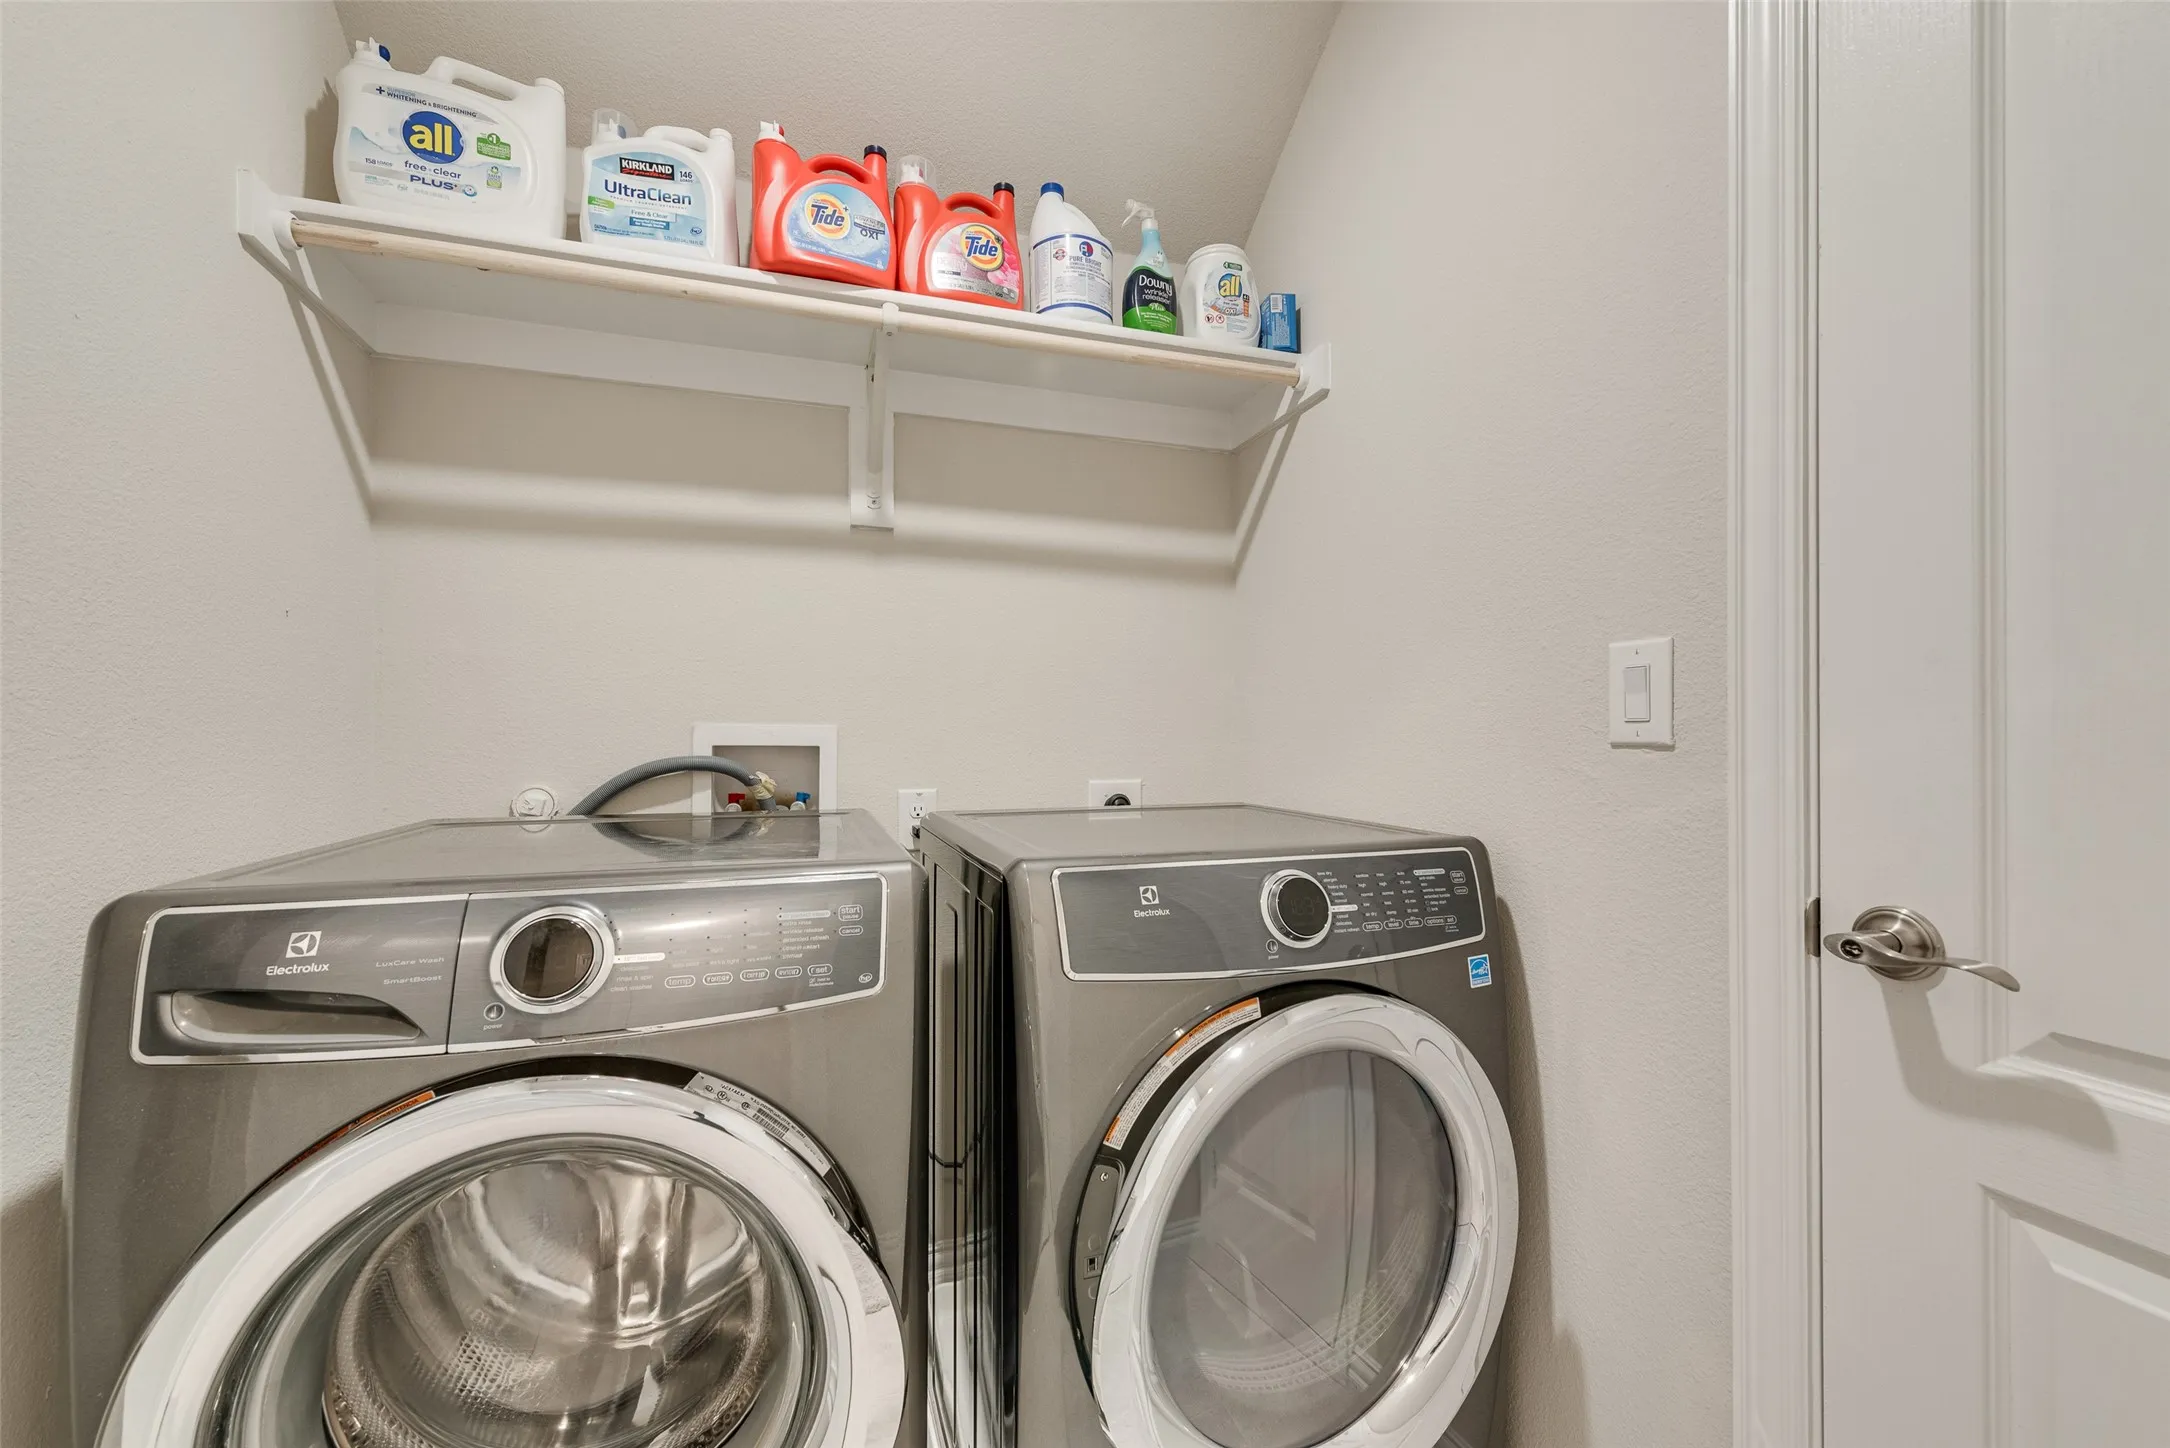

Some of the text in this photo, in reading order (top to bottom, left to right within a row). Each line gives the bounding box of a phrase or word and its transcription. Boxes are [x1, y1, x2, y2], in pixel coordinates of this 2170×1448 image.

[387, 92, 427, 106] WHITENING
[432, 102, 477, 118] BRIGHTENING
[409, 122, 456, 156] all
[404, 160, 461, 179] free clear
[621, 159, 673, 175] KIRKLAND
[679, 170, 693, 179] 146
[604, 179, 692, 206] UltraClean
[811, 203, 845, 227] Tide
[965, 236, 998, 257] Tide
[1069, 255, 1084, 263] PURE
[1139, 274, 1173, 297] Downy
[1143, 288, 1169, 299] wrinkle
[1219, 275, 1241, 297] all
[841, 906, 861, 914] start
[1133, 908, 1171, 918] Electrolux
[265, 961, 330, 977] Electrolux
[375, 956, 445, 968] LuxCare Wash
[383, 974, 443, 986] SmartBoost
